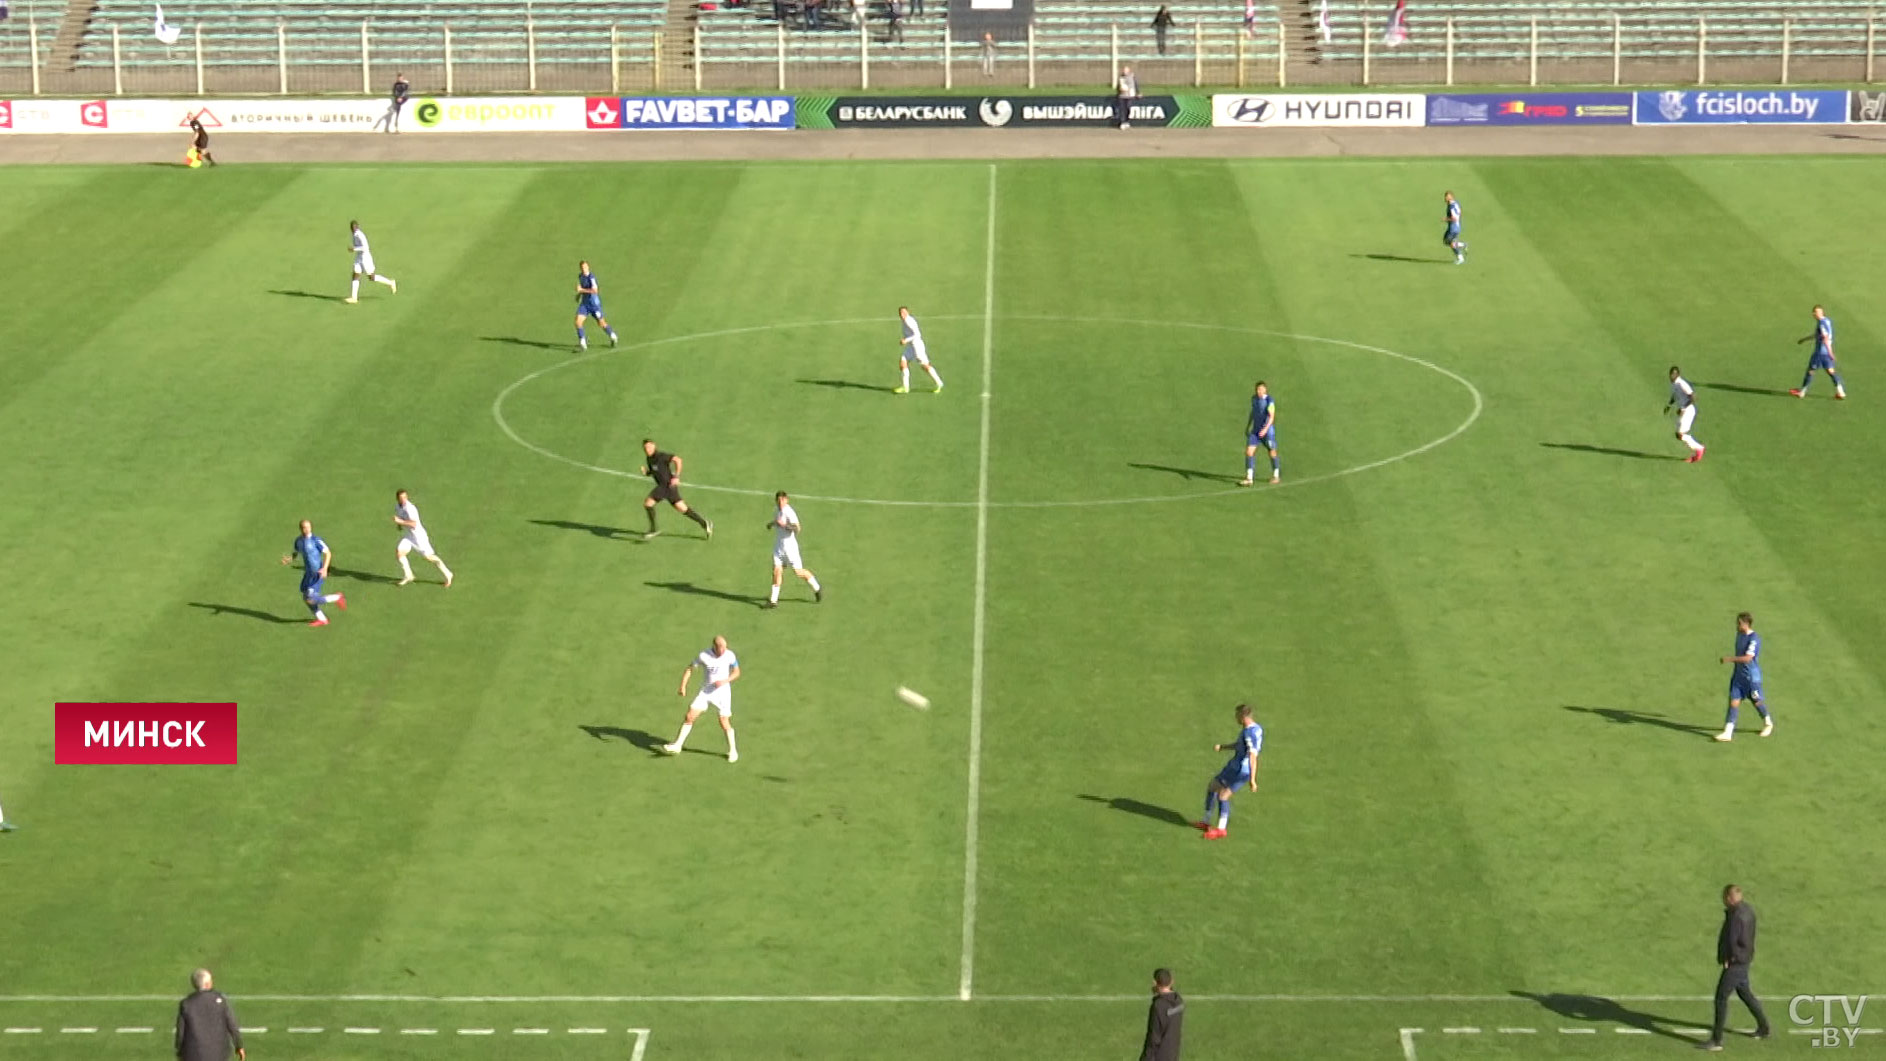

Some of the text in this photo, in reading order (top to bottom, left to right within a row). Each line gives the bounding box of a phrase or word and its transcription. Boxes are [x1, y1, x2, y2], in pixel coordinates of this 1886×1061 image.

[856, 106, 967, 120] БЕЛАРУСБАНК
[1285, 101, 1412, 119] HYUNDAI
[1696, 92, 1819, 119] fcisloch.by
